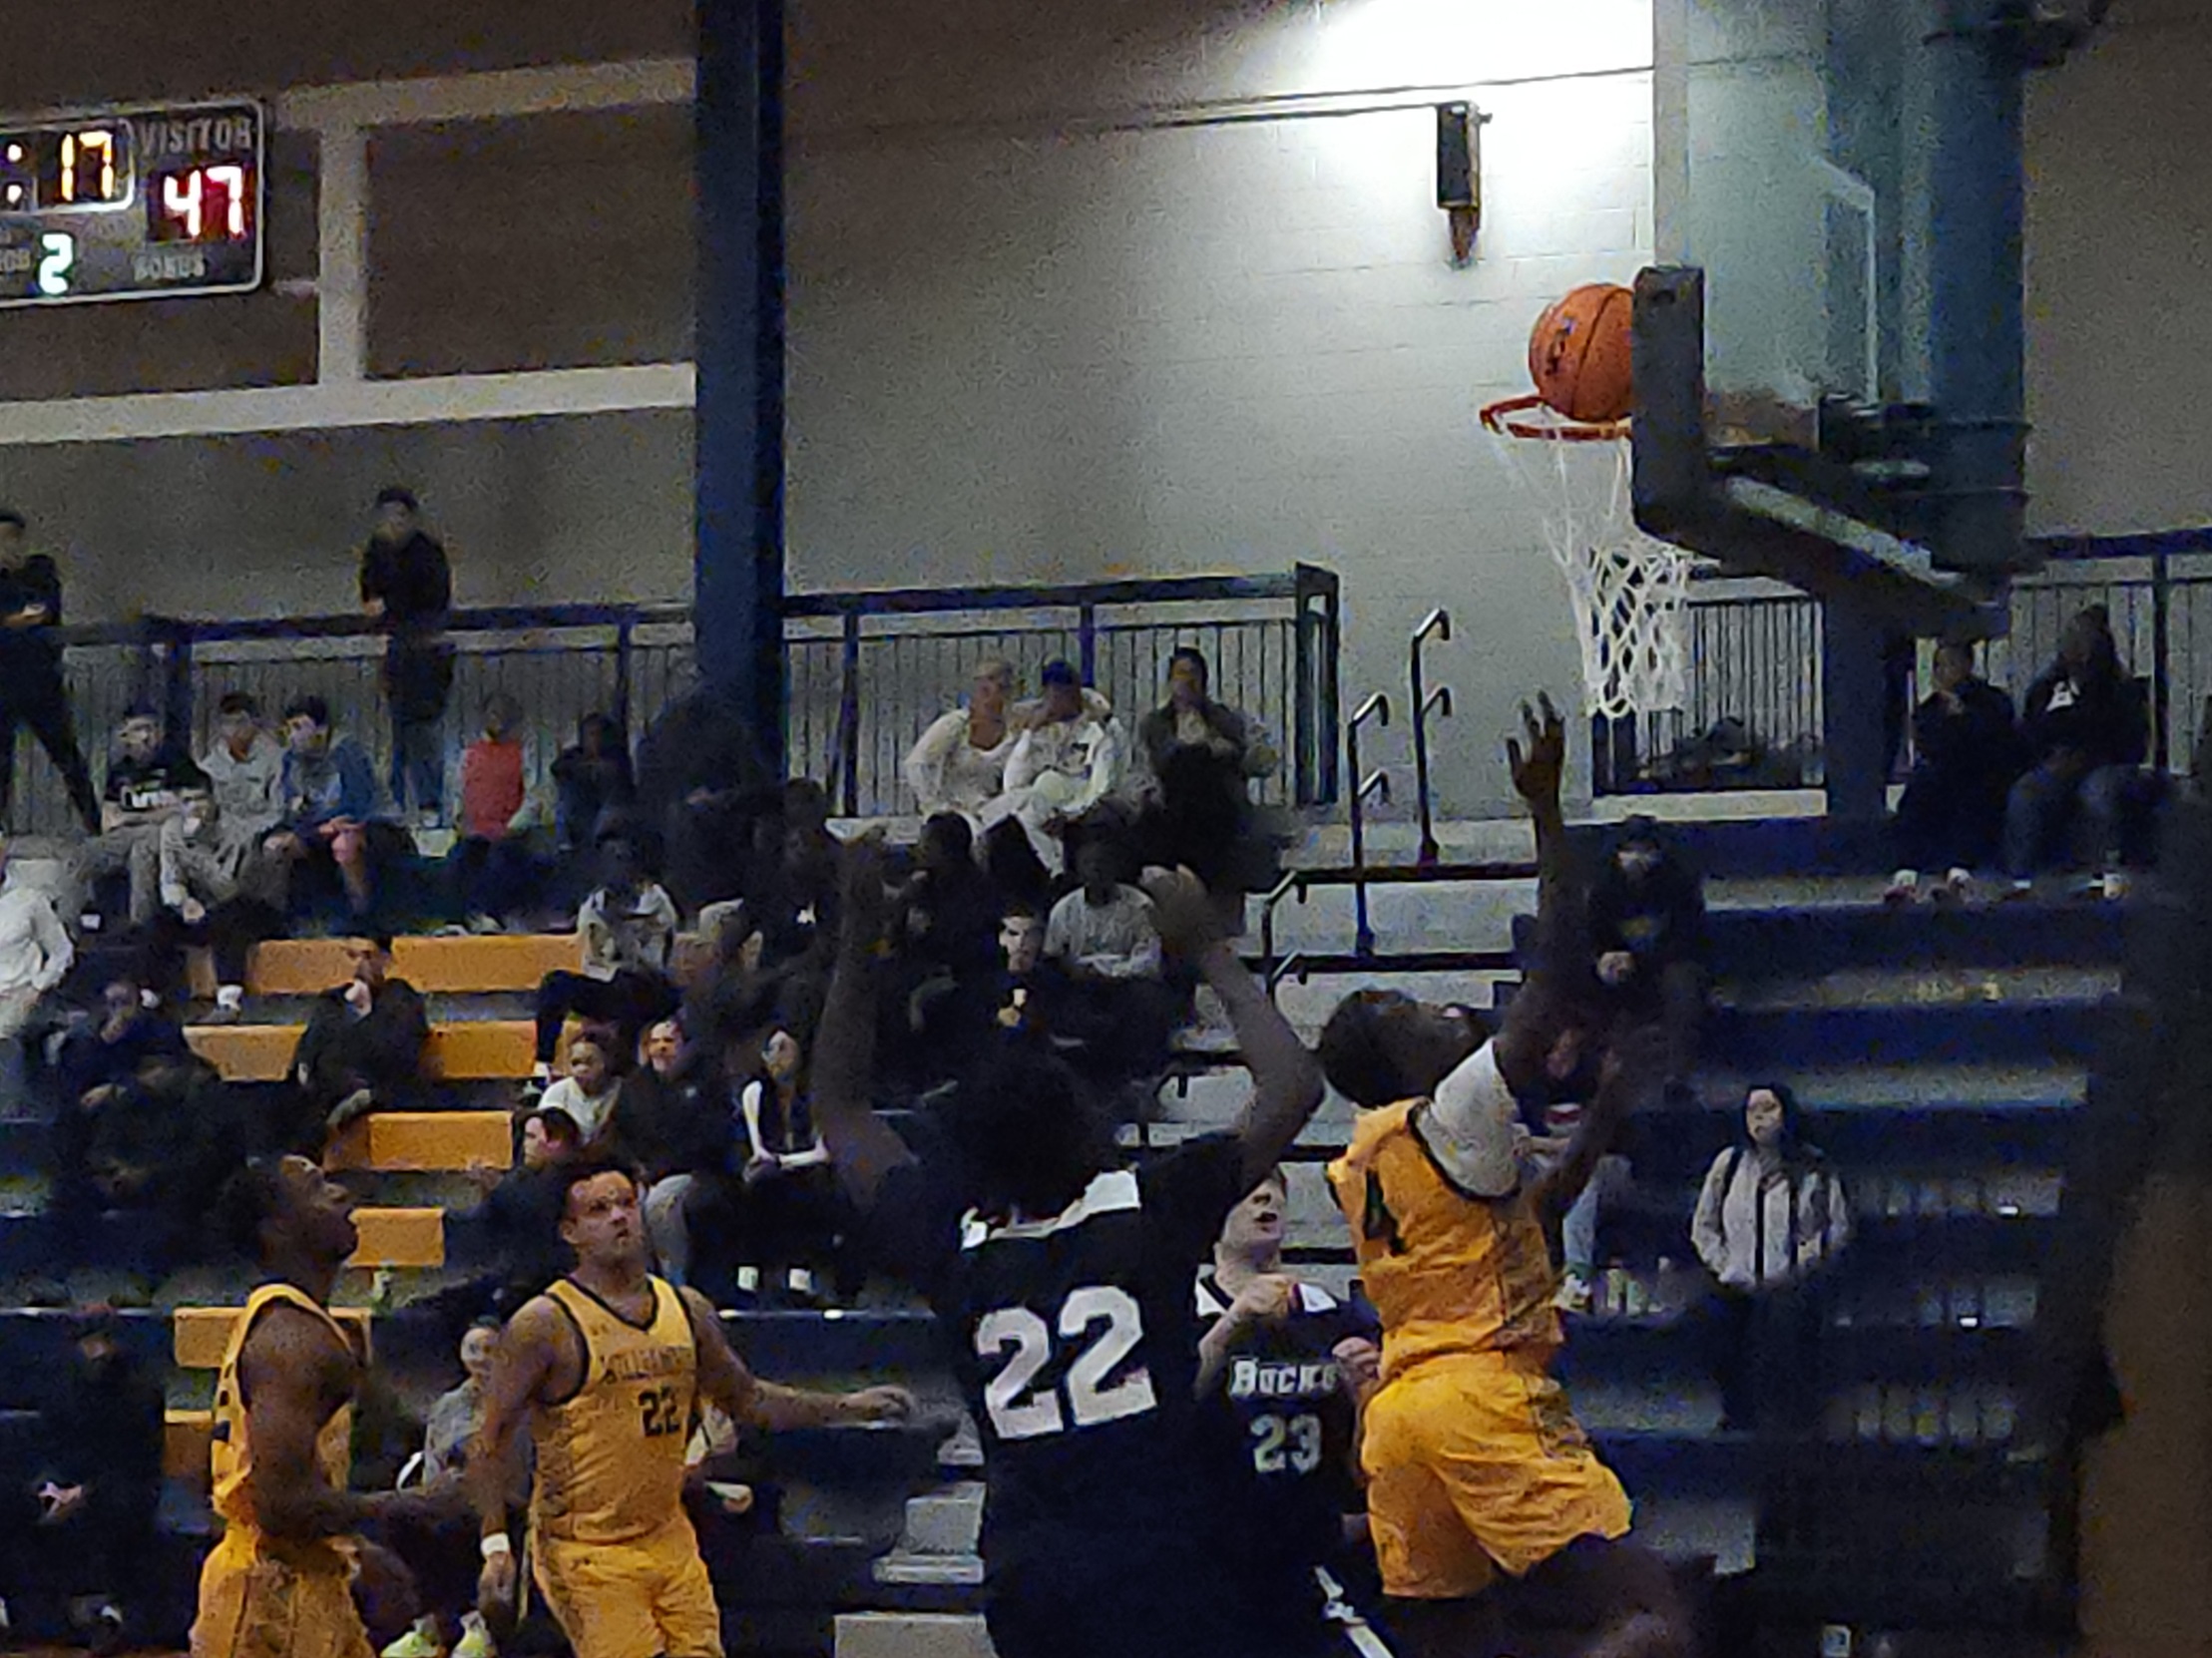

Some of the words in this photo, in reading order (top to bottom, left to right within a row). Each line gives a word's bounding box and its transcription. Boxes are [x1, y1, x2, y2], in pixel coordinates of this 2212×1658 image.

[141, 117, 252, 155] VISITOR
[163, 166, 242, 237] 47
[39, 233, 73, 294] 2
[976, 1285, 1157, 1440] 22
[637, 1386, 680, 1438] 22
[1249, 1413, 1324, 1473] 23
